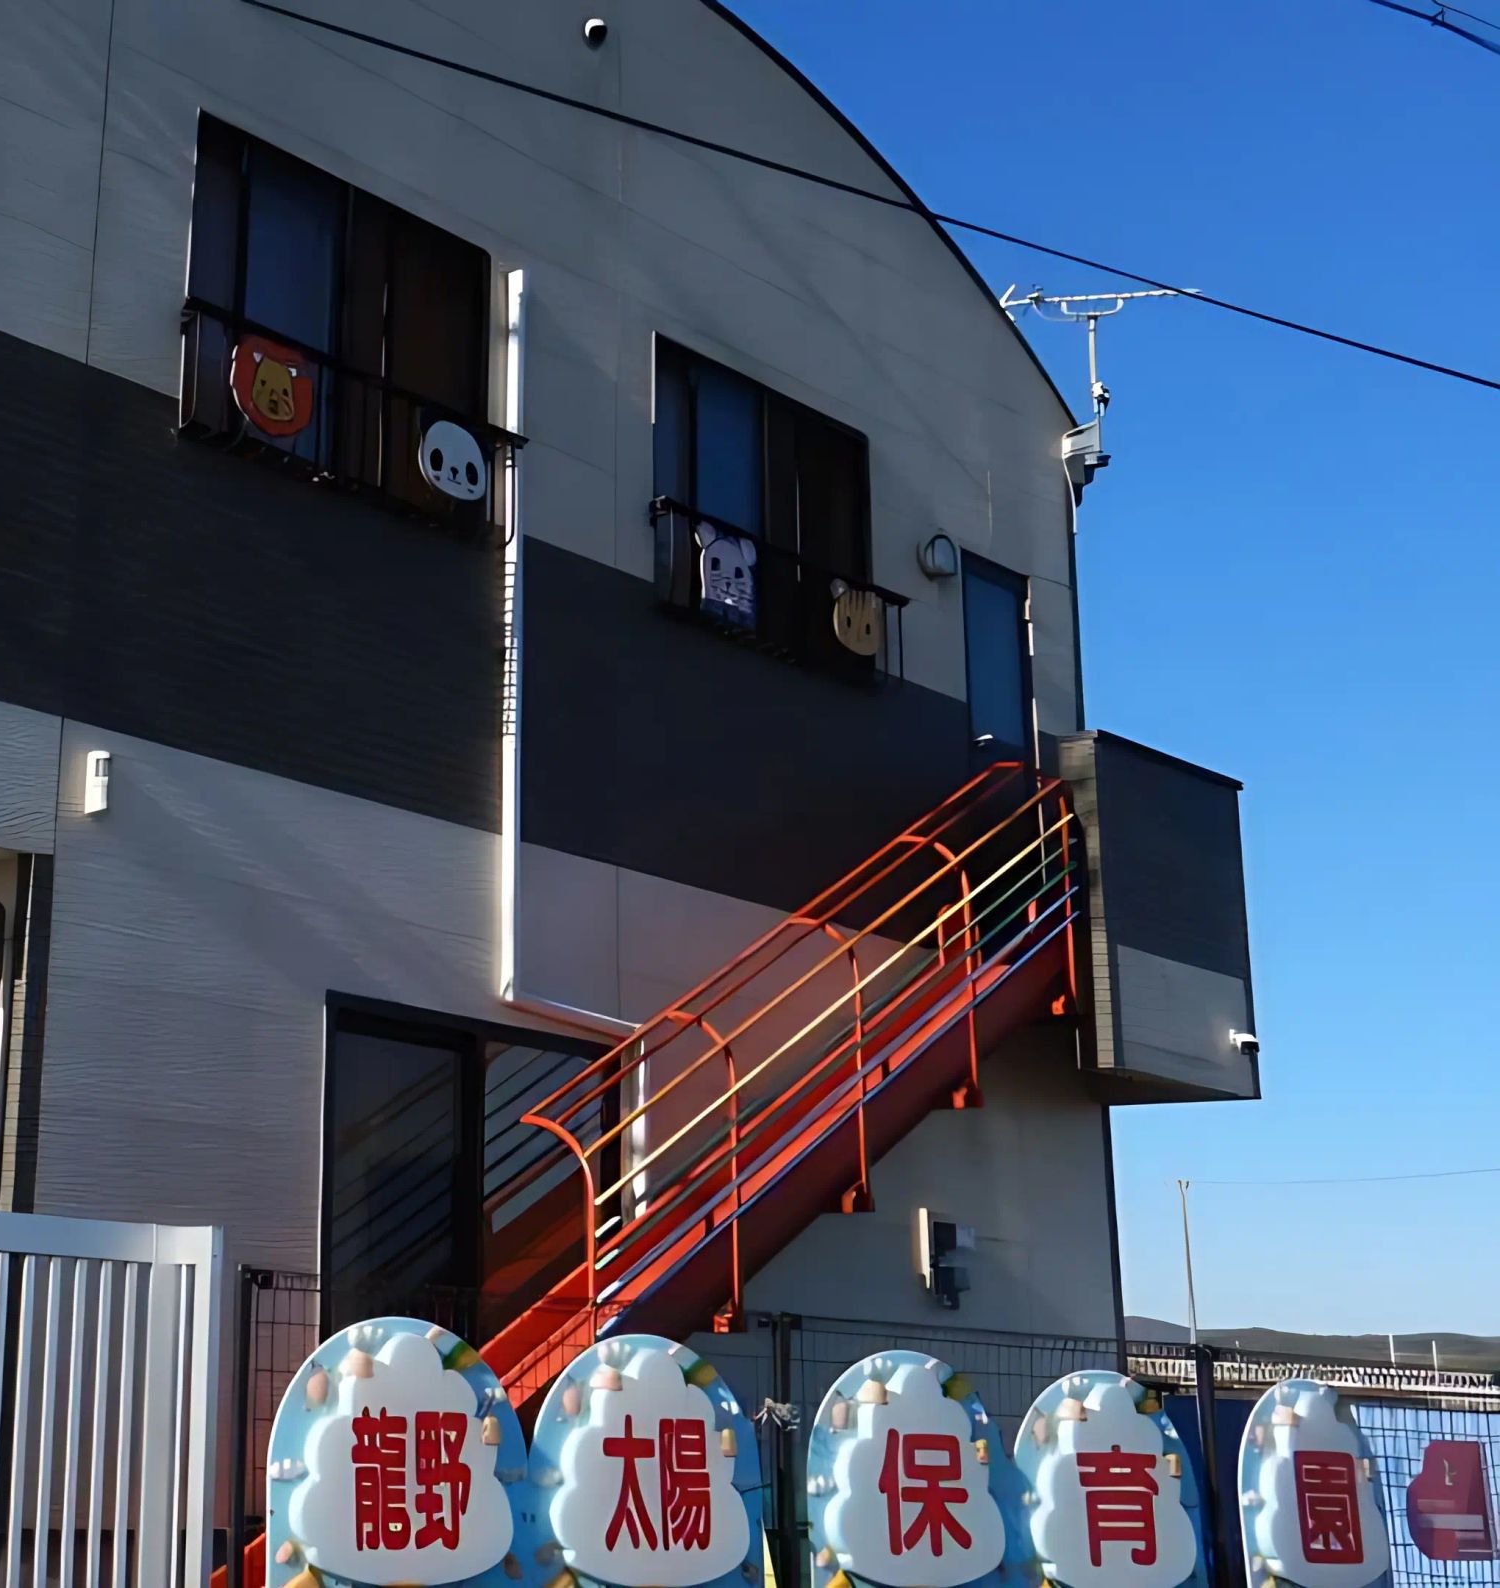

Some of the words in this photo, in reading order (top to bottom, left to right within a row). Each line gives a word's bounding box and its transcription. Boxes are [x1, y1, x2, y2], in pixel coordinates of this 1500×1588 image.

[351, 1407, 472, 1551] 龍野
[602, 1415, 711, 1551] 太陽
[878, 1428, 972, 1556] 保
[1076, 1446, 1159, 1567] 育
[1294, 1450, 1364, 1564] 園
